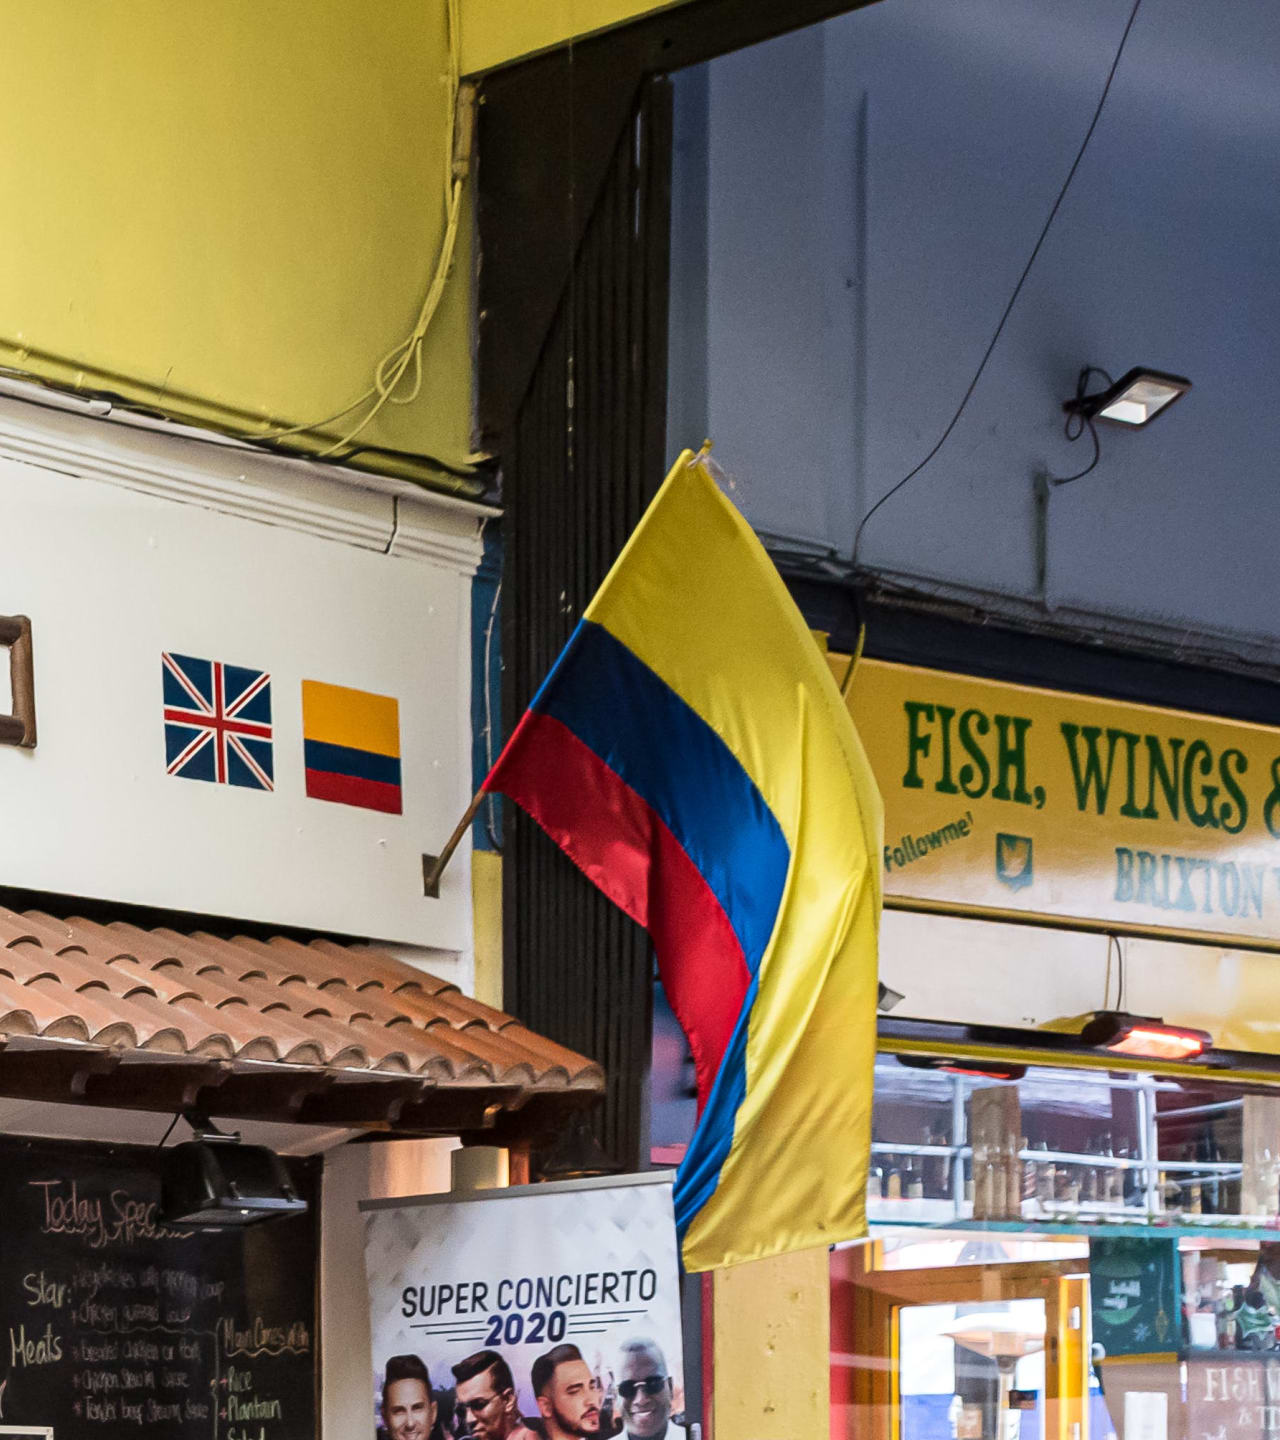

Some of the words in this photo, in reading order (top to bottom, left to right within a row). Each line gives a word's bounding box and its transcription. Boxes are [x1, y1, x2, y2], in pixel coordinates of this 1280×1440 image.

[902, 701, 1047, 810] FISH,
[1060, 721, 1249, 834] WINGS
[1113, 847, 1265, 919] BRIXTON
[28, 1179, 104, 1248] Today
[110, 1189, 160, 1242] Spec
[401, 1280, 489, 1319] SUPER
[496, 1268, 657, 1312] CONCIERTO
[484, 1310, 568, 1347] 2020
[1204, 1367, 1264, 1402] FISH
